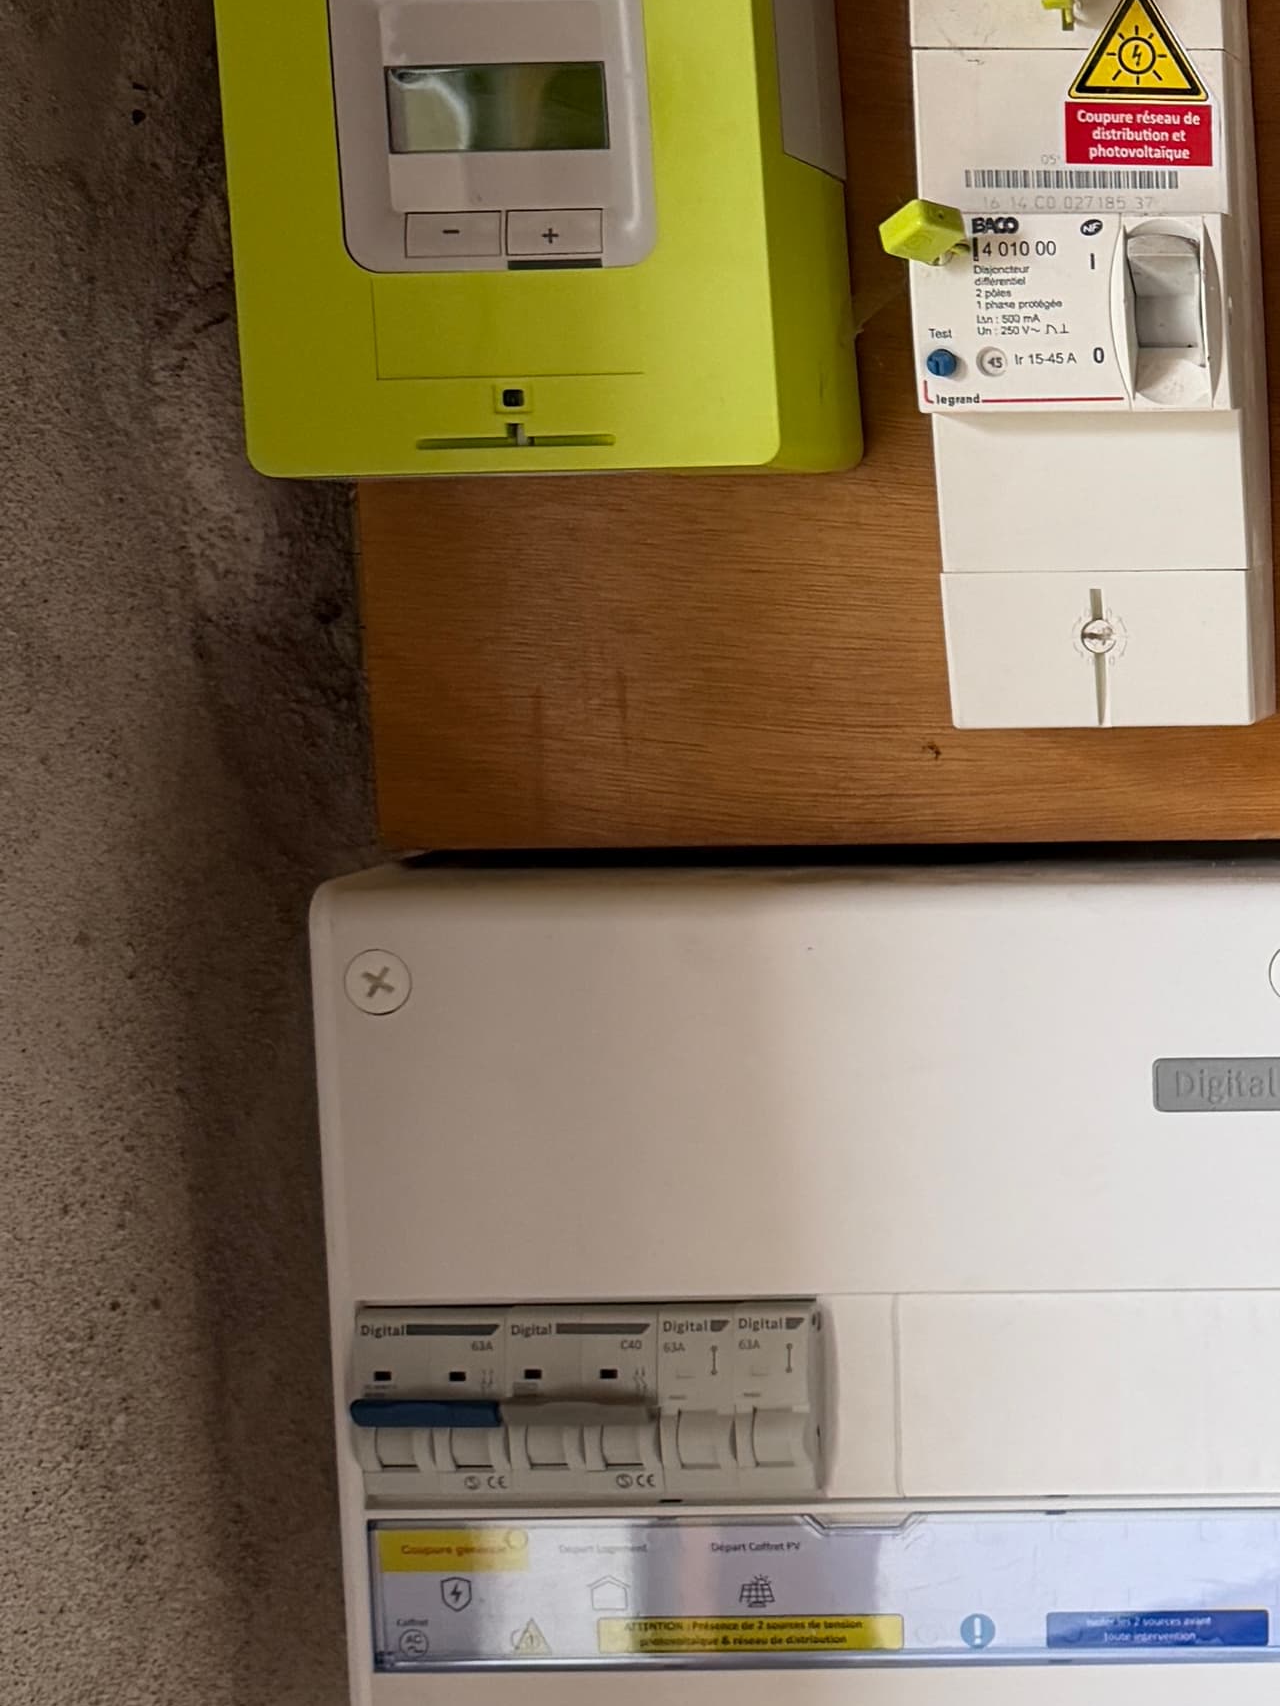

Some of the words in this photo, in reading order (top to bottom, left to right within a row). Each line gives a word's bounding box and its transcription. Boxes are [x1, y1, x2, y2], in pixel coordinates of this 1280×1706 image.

[1077, 110, 1134, 126] Coupure
[1135, 110, 1181, 125] réseau
[1183, 111, 1201, 125] de
[1091, 127, 1170, 142] distribution
[1172, 129, 1187, 142] et
[1088, 144, 1191, 161] photovoltaïque
[971, 217, 1019, 234] BACO
[1081, 221, 1103, 235] NF
[973, 265, 1030, 276] Disjoncteur
[974, 276, 1026, 287] différentiel
[976, 288, 982, 298] 2
[985, 287, 1012, 299] pôles
[985, 300, 1016, 310] phase
[1018, 298, 1063, 310] protégée
[928, 328, 952, 340] Test
[1028, 353, 1063, 365] 15-45
[1065, 352, 1077, 364] A
[1175, 1068, 1277, 1104] Digital
[361, 1324, 406, 1339] Digital
[511, 1324, 552, 1337] Digital
[471, 1340, 494, 1351] 63A
[620, 1339, 643, 1350] C40
[741, 1619, 755, 1631] de
[823, 1619, 863, 1630] tension
